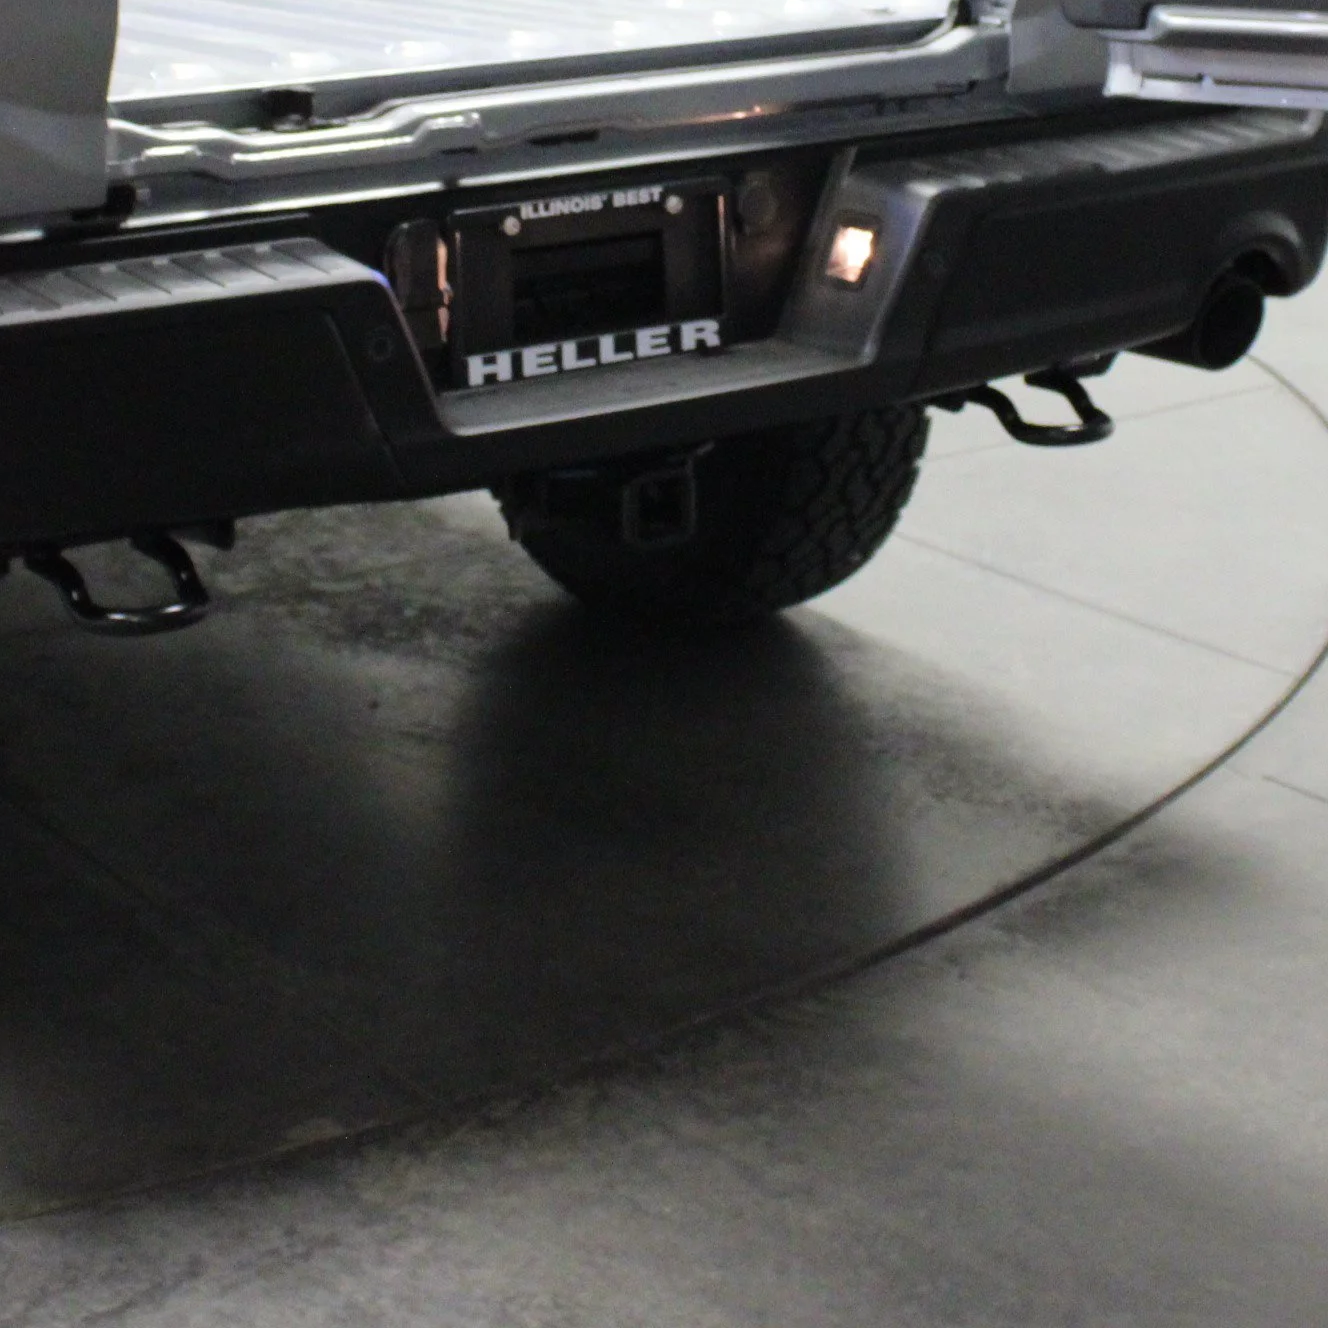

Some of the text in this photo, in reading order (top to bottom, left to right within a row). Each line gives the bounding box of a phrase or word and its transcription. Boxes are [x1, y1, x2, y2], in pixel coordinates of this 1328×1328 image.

[519, 186, 664, 220] ILLINOIS' BEST
[467, 319, 721, 387] HELLER
